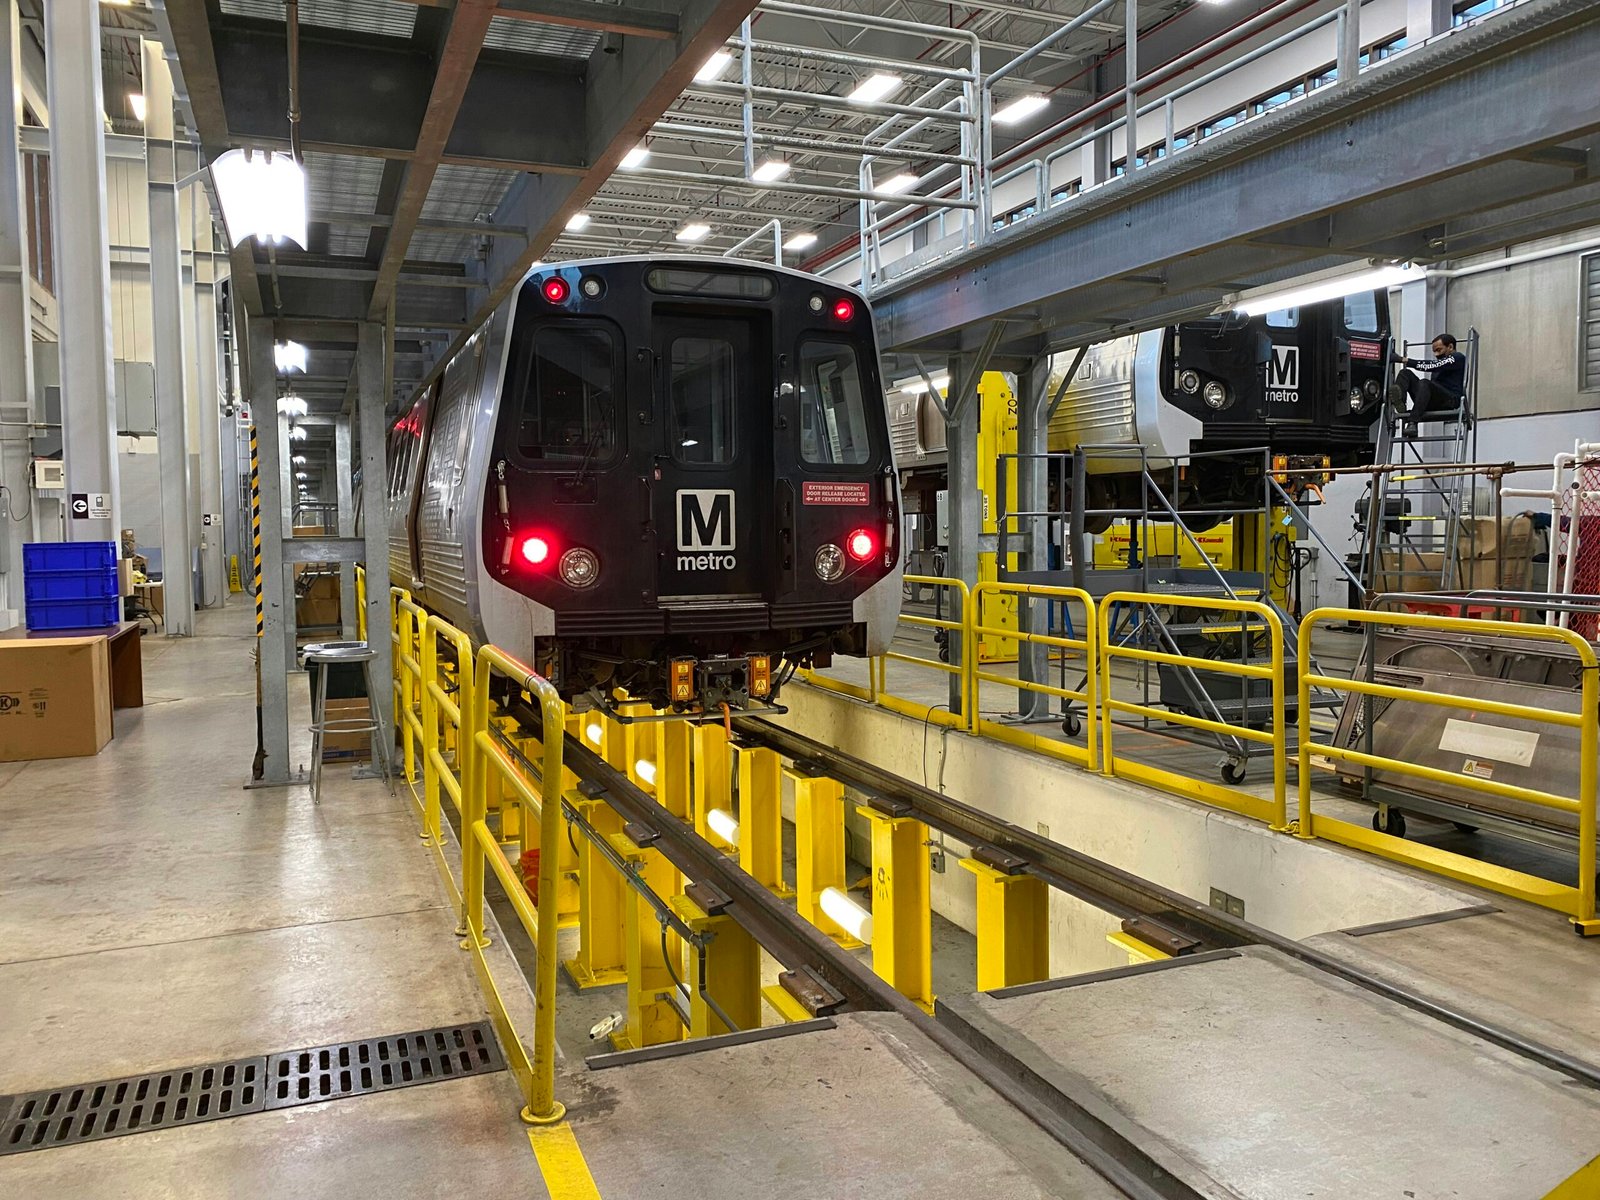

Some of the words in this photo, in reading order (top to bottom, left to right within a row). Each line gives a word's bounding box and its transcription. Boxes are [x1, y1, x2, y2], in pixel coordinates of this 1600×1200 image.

[1268, 349, 1296, 386] M
[1265, 390, 1299, 402] metro
[681, 494, 731, 546] M
[677, 552, 736, 571] metro
